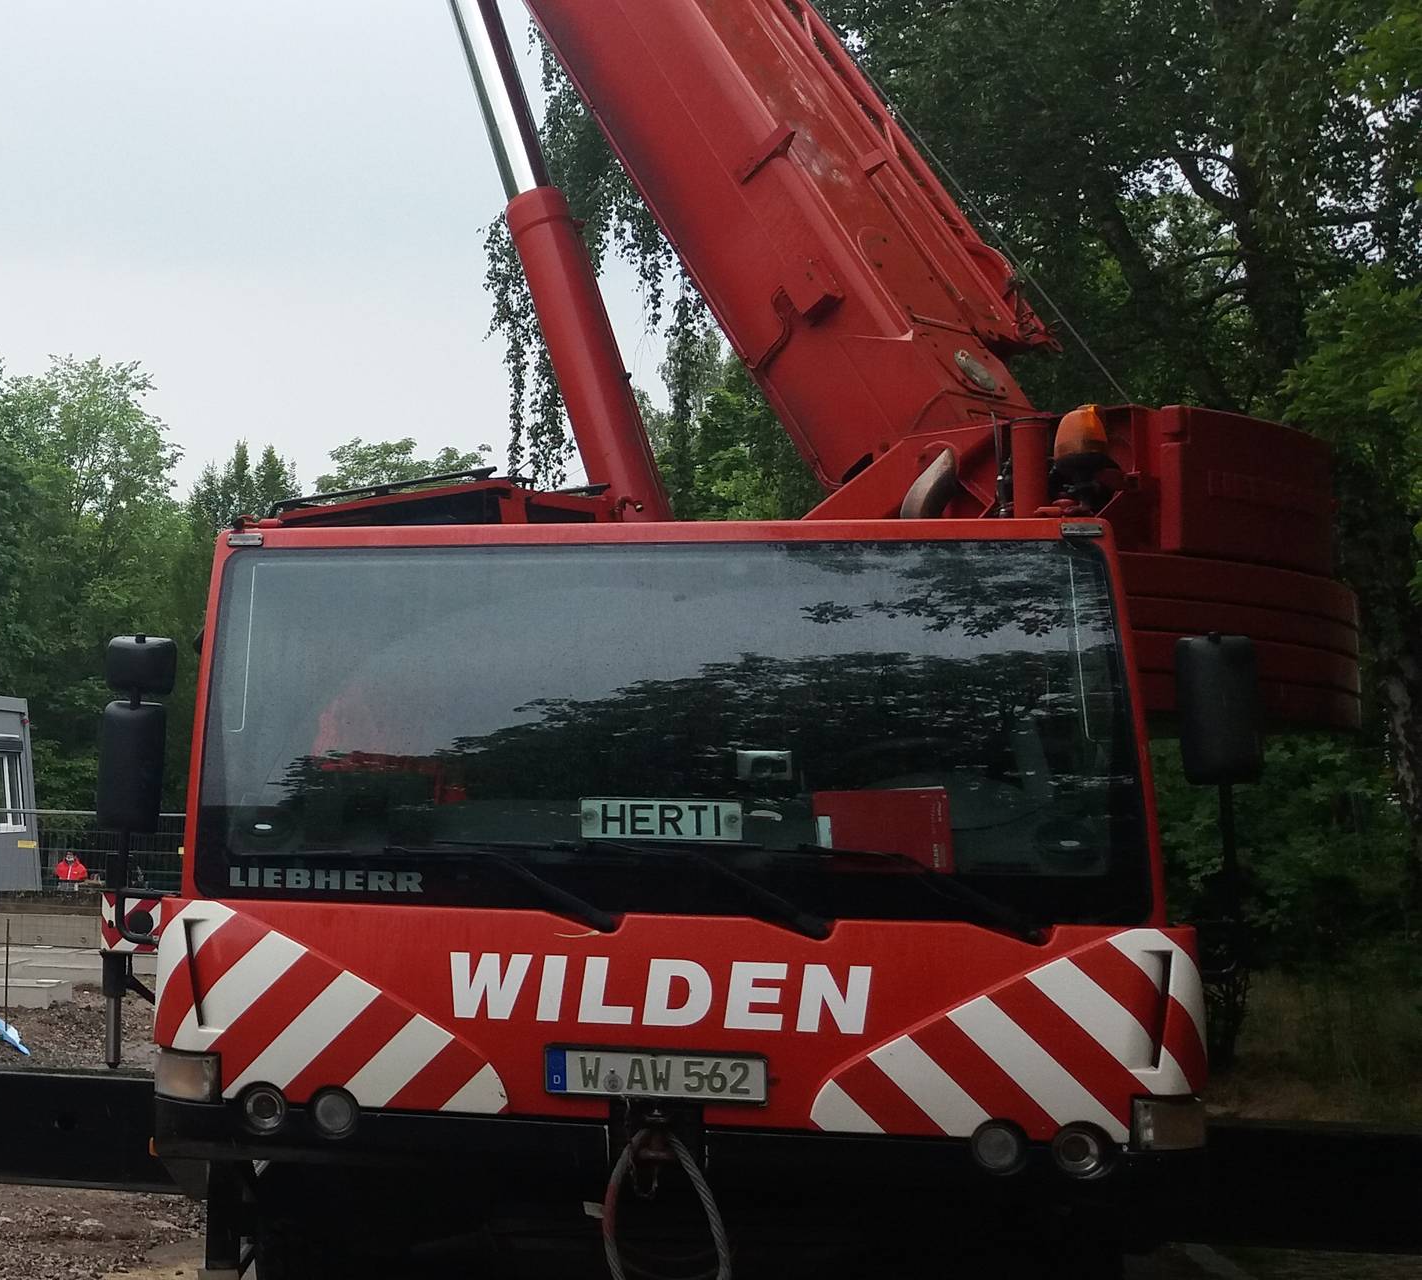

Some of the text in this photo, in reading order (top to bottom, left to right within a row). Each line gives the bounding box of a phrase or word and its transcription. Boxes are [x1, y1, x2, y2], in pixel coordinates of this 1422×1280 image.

[600, 802, 722, 837] HERTI
[228, 866, 424, 893] LIEBHERR
[449, 951, 873, 1035] WILDEN
[552, 1056, 750, 1096] D W AW 562
